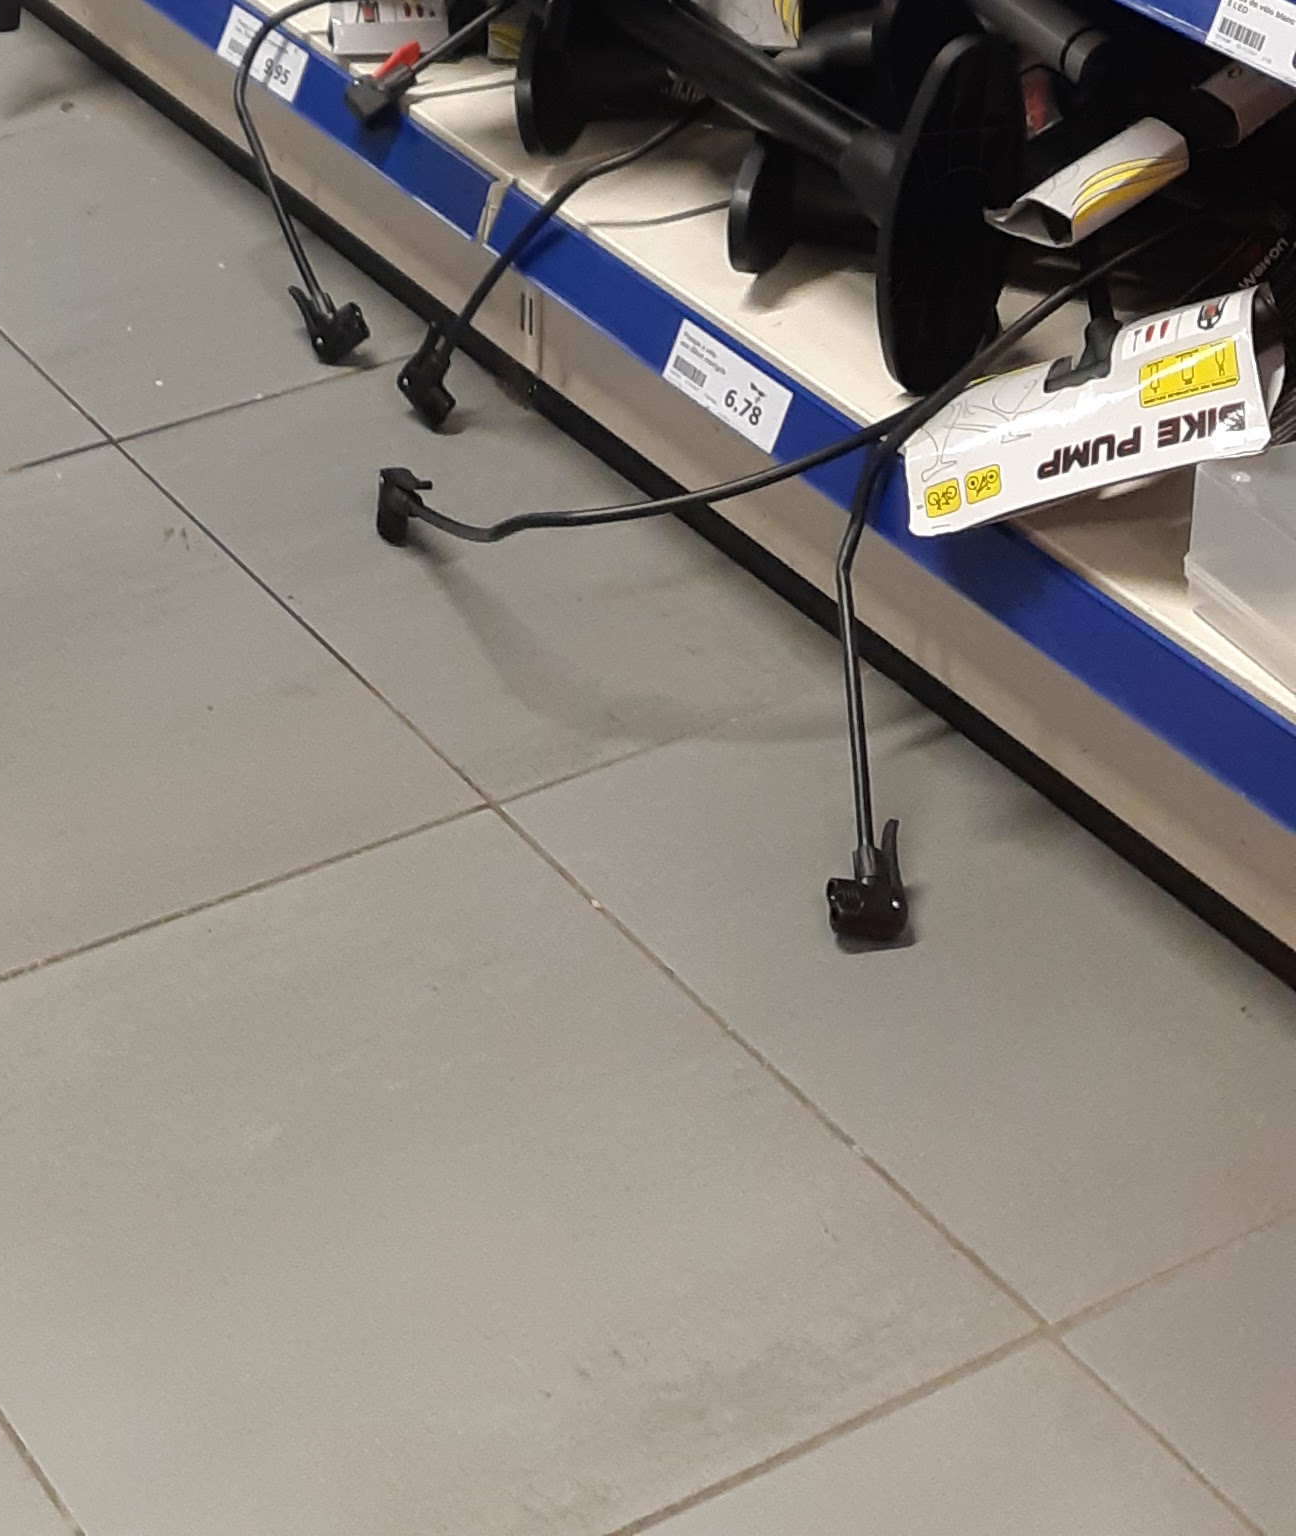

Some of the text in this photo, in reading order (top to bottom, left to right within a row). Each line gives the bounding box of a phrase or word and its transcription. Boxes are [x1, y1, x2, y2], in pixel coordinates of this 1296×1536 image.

[723, 389, 763, 427] 6.78
[1036, 400, 1247, 480] BIKE PUMP
